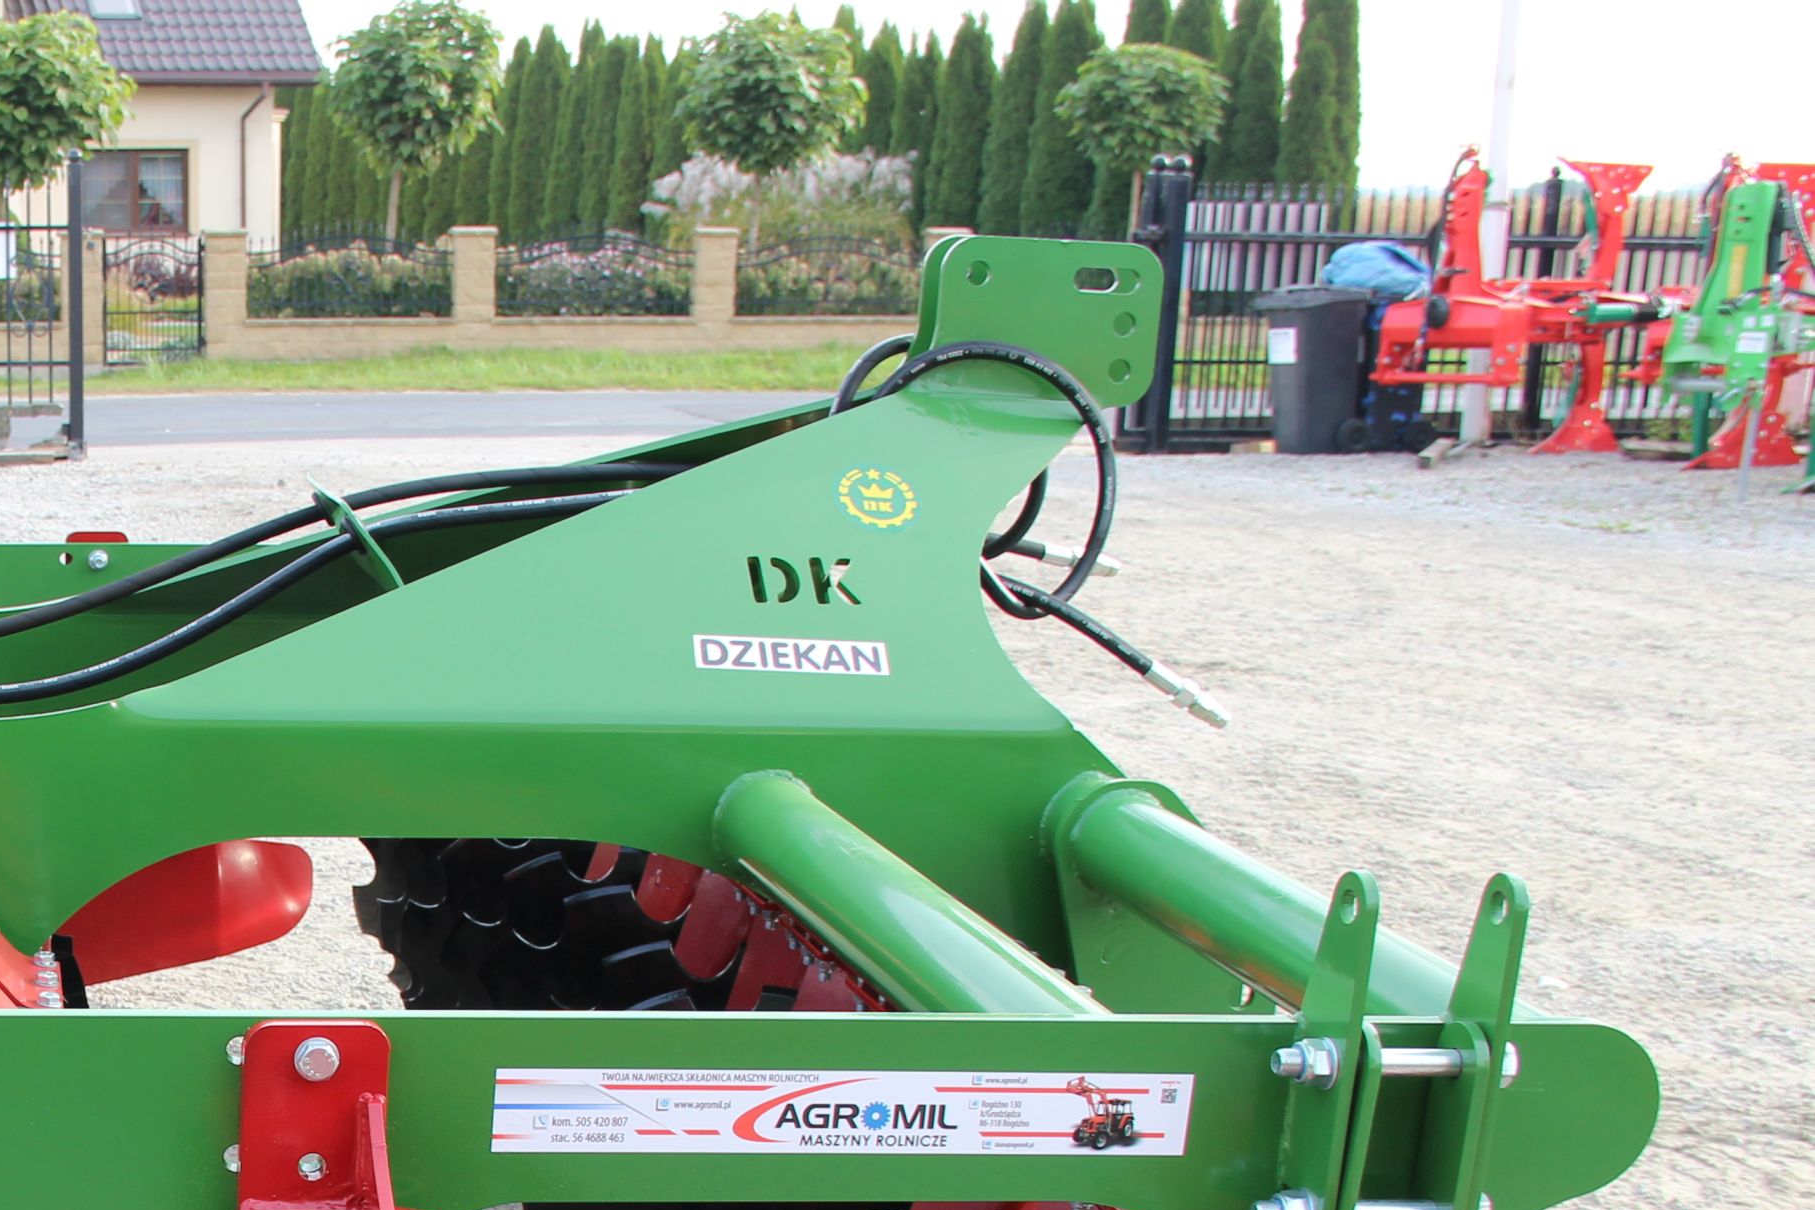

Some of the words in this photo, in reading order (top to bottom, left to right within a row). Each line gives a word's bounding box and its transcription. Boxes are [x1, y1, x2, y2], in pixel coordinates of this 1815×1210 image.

[746, 555, 862, 605] DK
[699, 637, 883, 674] DZIEKAN
[601, 1073, 630, 1082] TWOJA
[631, 1073, 684, 1083] NAJWIĘKSZA
[685, 1073, 732, 1082] SKŁADNICA
[733, 1073, 767, 1082] MASZYN
[768, 1074, 820, 1083] ROLNICZYCH
[673, 1100, 732, 1110] www.agromil.pl
[551, 1116, 573, 1127] kom.
[575, 1116, 592, 1127] 505
[593, 1116, 610, 1127] 420
[611, 1117, 629, 1127] 807
[774, 1101, 959, 1131] AGROMIL
[550, 1133, 570, 1143] stac.
[572, 1133, 584, 1143] 56
[585, 1133, 607, 1143] 4688
[608, 1133, 625, 1143] 463
[799, 1134, 872, 1147] MASZYNY
[875, 1135, 948, 1148] ROLNICZE
